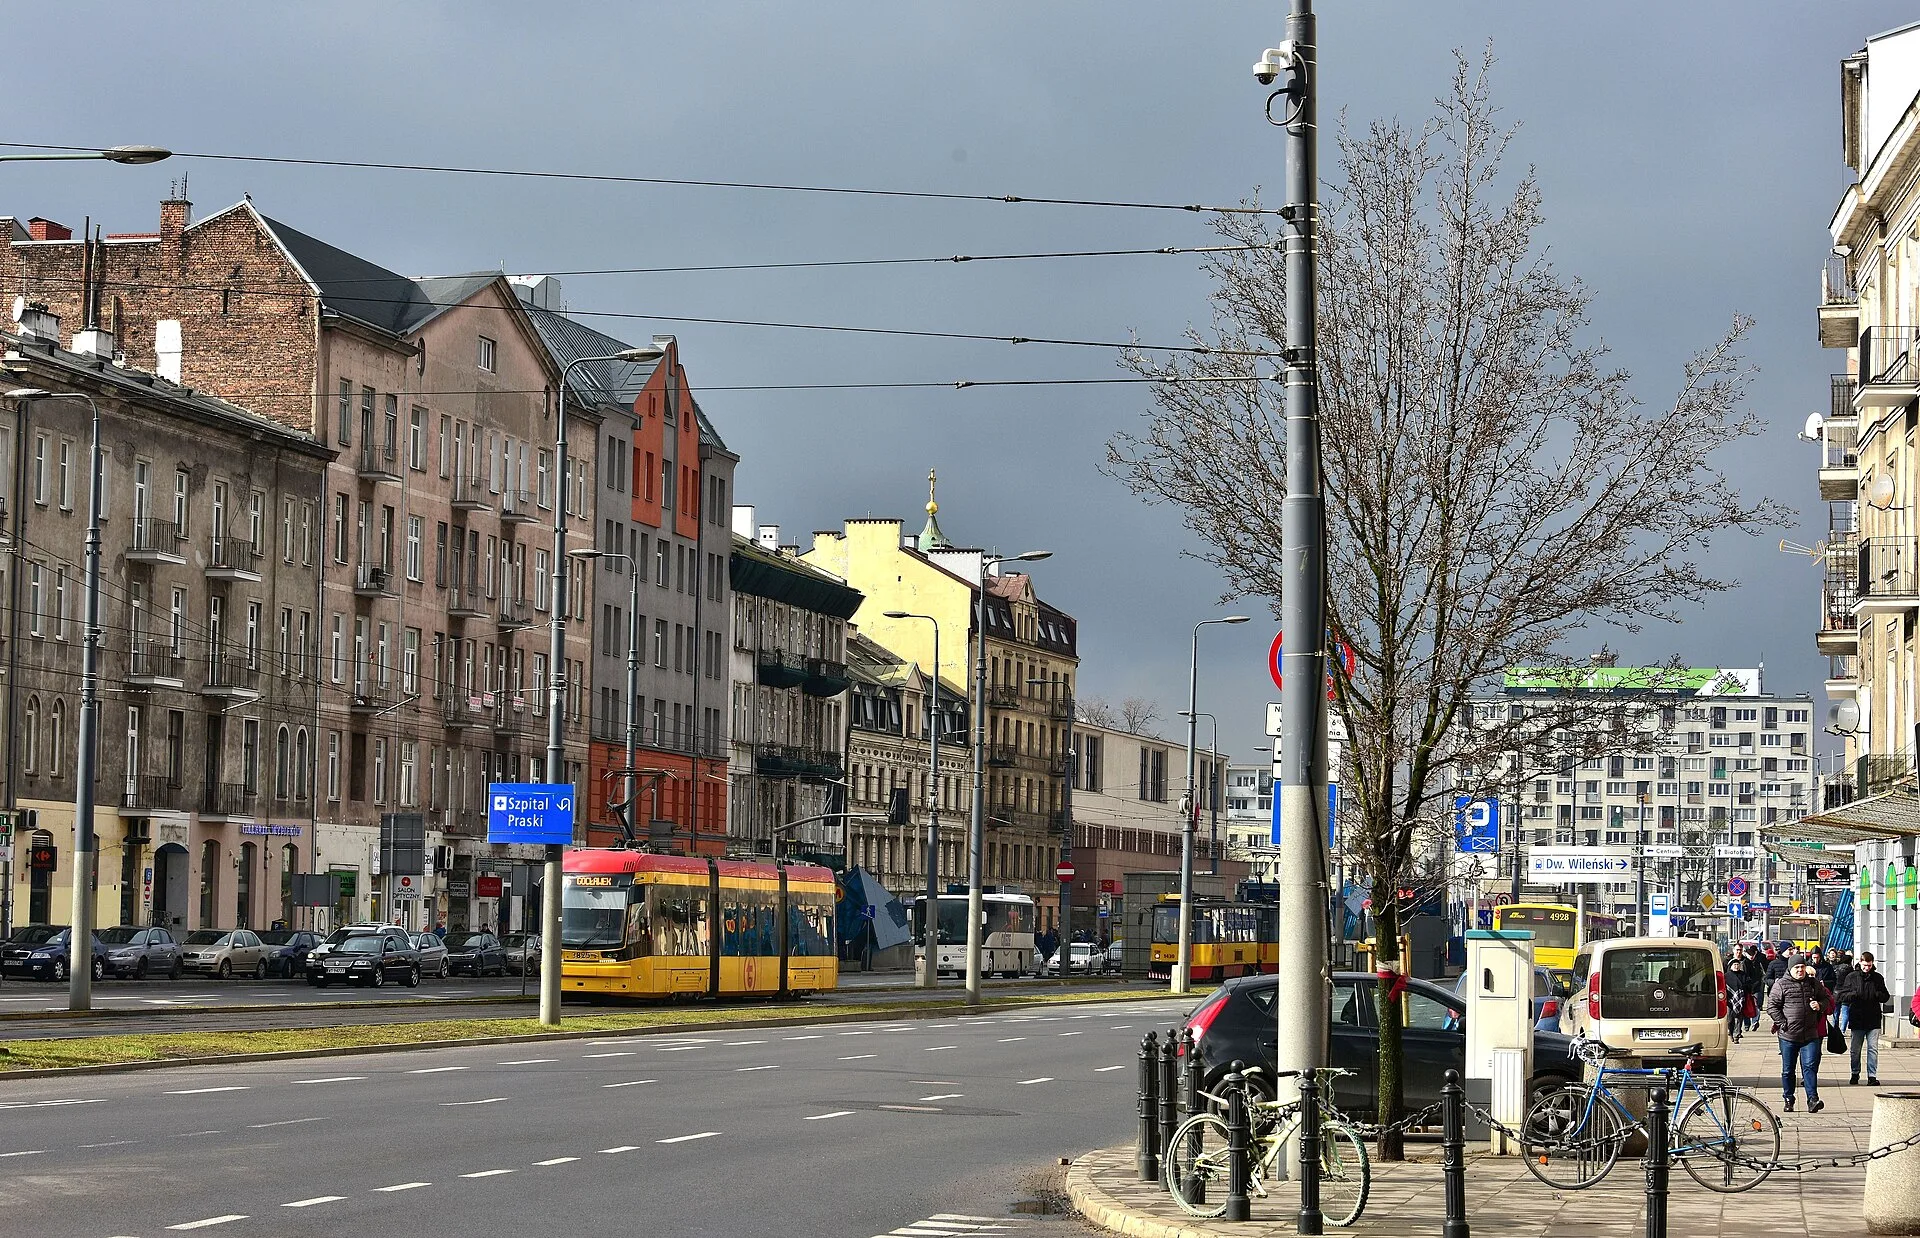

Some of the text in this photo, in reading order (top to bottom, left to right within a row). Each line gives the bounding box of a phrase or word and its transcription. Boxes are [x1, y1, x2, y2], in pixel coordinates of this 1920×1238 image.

[508, 797, 549, 813] Szpital
[508, 813, 544, 827] Praski
[1546, 858, 1614, 870] Dw. Wileński
[576, 876, 612, 886] GOCŁAWEK
[1549, 912, 1570, 921] 4928
